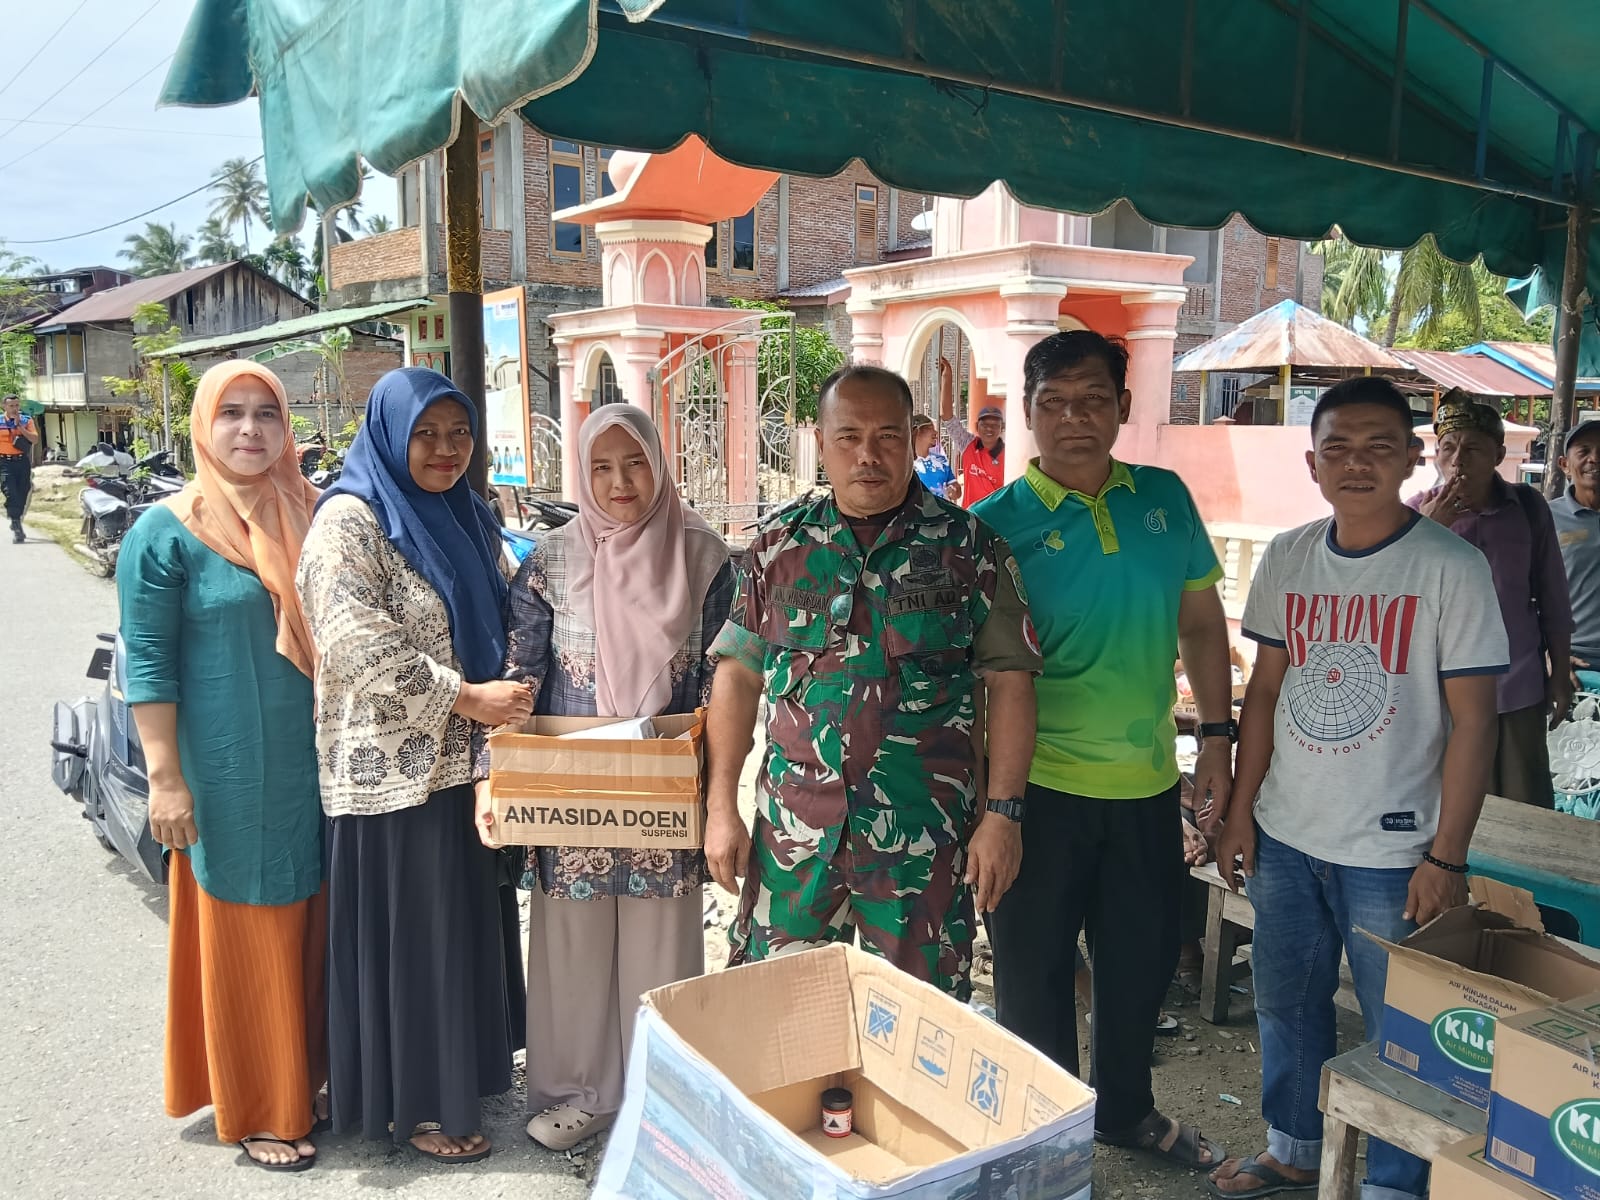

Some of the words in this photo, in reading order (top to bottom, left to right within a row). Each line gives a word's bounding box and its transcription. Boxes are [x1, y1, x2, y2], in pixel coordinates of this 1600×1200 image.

[895, 593, 926, 611] TNI
[1285, 592, 1421, 675] BEYOND
[1286, 721, 1323, 754] THINGS
[1332, 742, 1361, 755] YOU
[1368, 705, 1398, 742] KNOW
[504, 805, 619, 827] ANTASIDA
[623, 809, 687, 829] DOEN
[641, 829, 688, 838] SUSPENSI
[1449, 980, 1461, 989] AIR
[1463, 985, 1488, 1001] MINUM
[1489, 996, 1517, 1012] DALAM
[1463, 993, 1499, 1013] KEMASAN
[1445, 1040, 1456, 1049] Air
[1459, 1045, 1489, 1064] Mineral
[1572, 1062, 1589, 1075] AIR
[1570, 1139, 1584, 1151] Air
